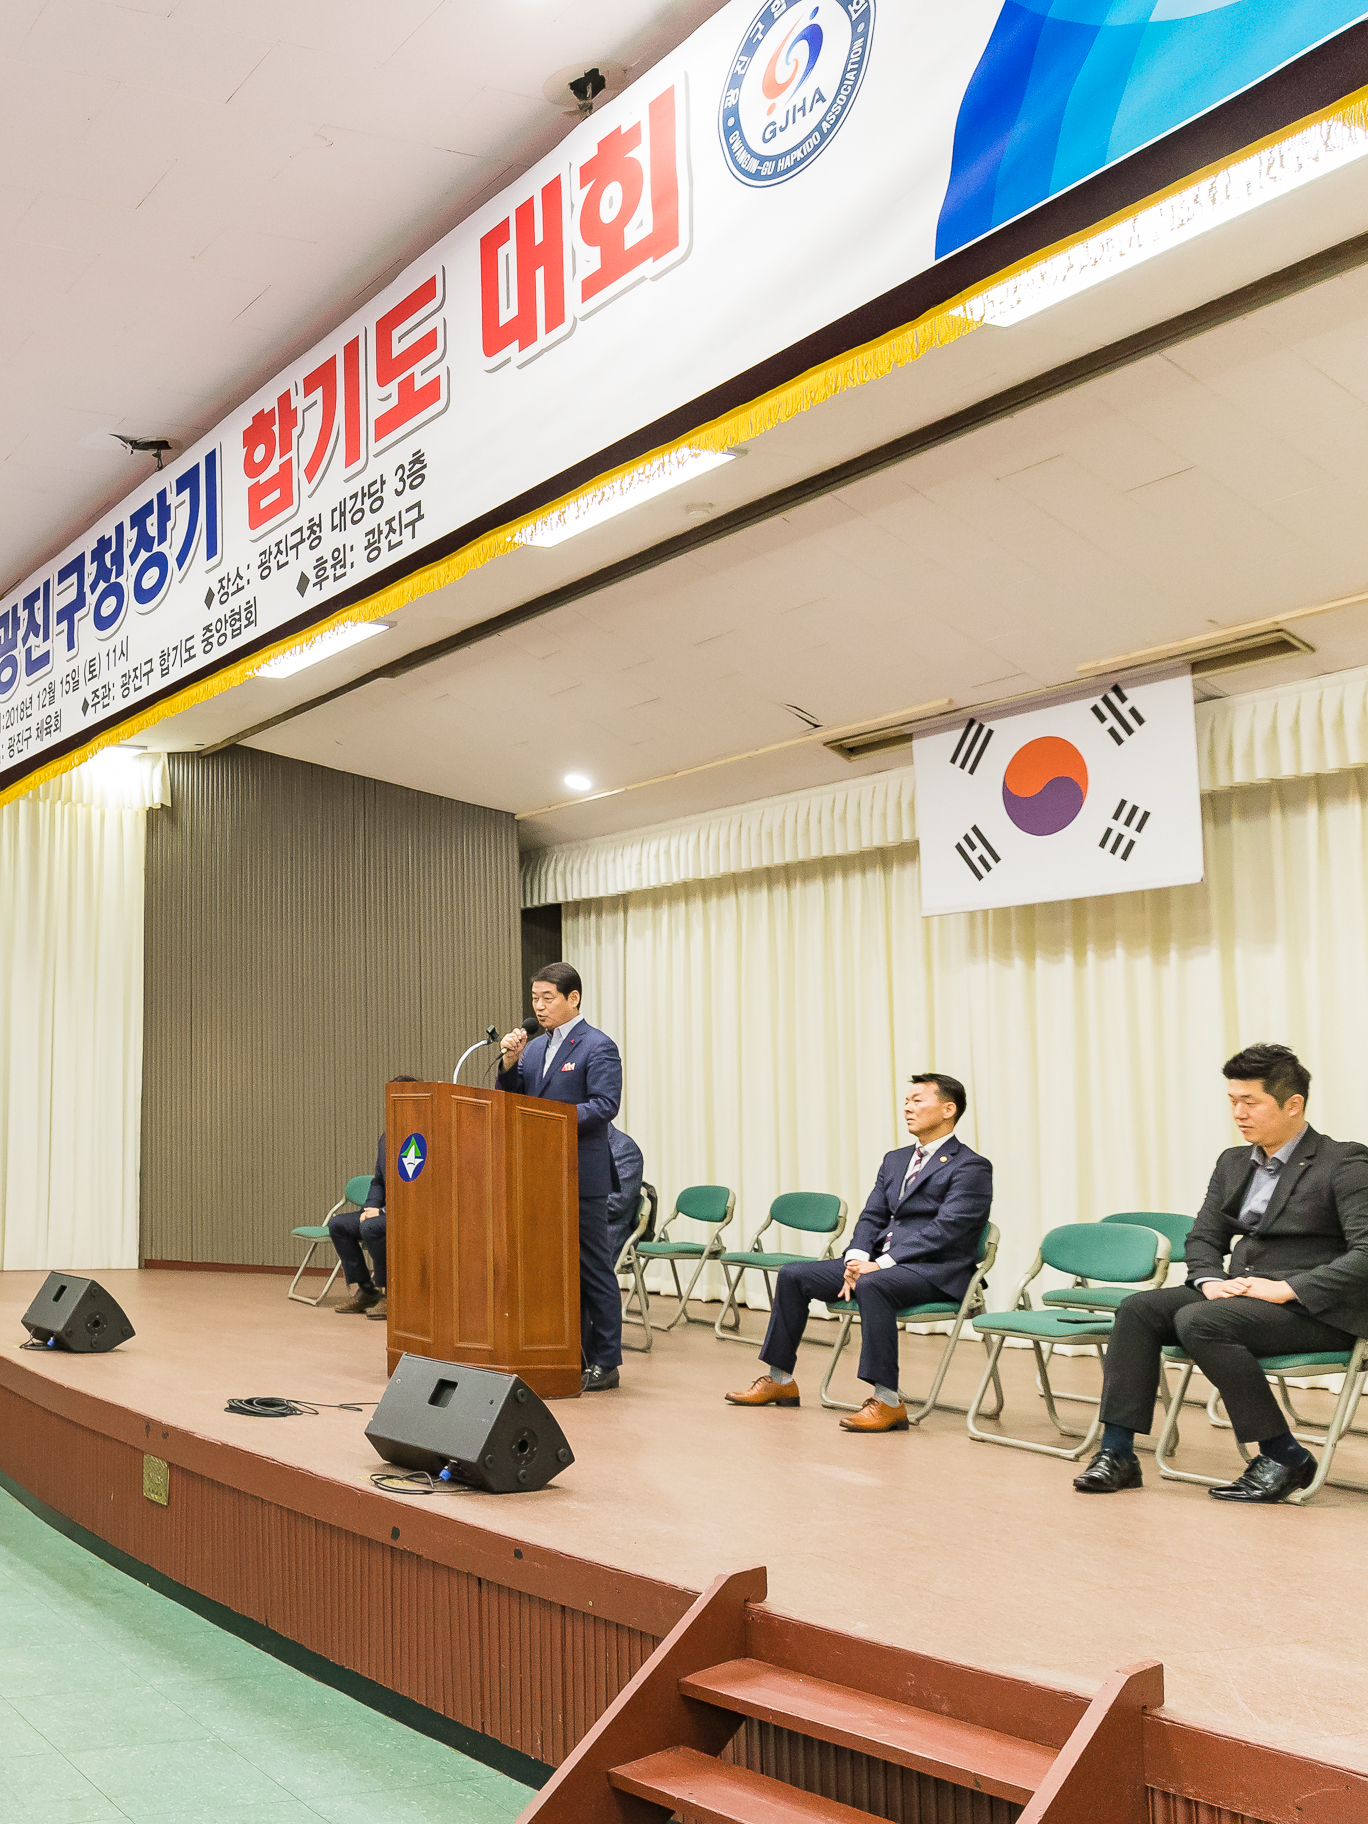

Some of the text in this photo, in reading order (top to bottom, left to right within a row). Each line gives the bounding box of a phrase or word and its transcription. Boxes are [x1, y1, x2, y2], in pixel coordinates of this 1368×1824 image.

[762, 87, 827, 144] GJHA
[777, 131, 821, 173] HAPKIDO
[821, 37, 865, 134] ASSOCIATION
[242, 274, 441, 530] 합기도
[480, 83, 680, 358] 대회
[217, 449, 428, 605] 장소: 광진구청 대강당 3층
[313, 501, 425, 591] 후원: 광진구
[36, 679, 56, 714] 12월
[60, 666, 81, 701] 15일
[84, 655, 102, 688] (토)
[105, 636, 129, 673] 11시
[90, 596, 258, 714] 주관: 광진구 합기도 중앙협회
[7, 728, 32, 761] 광진구
[35, 708, 62, 745] 체육회
